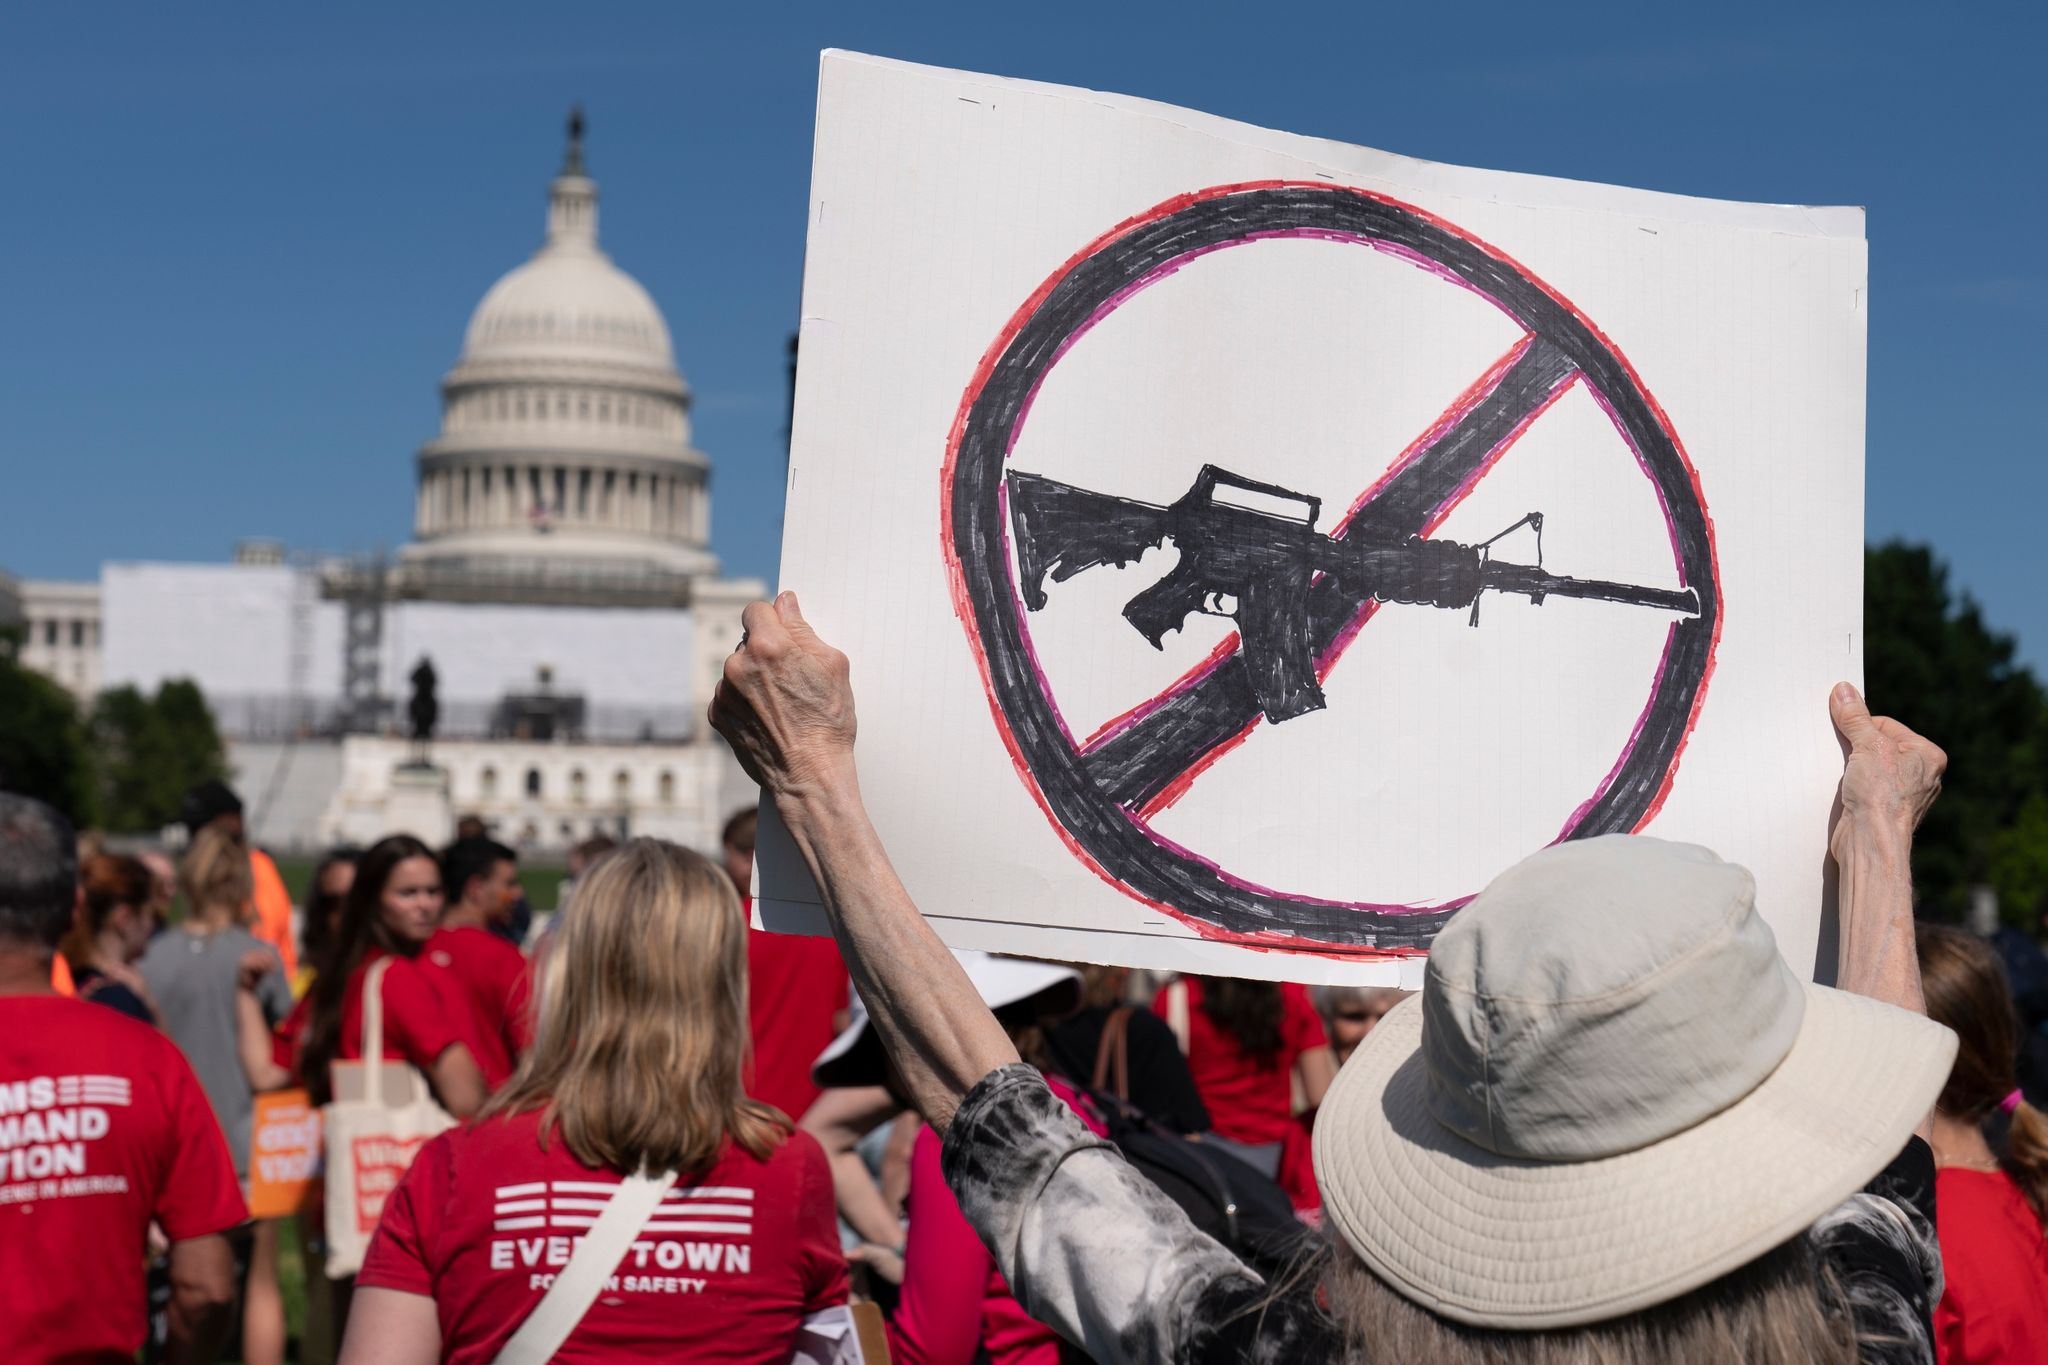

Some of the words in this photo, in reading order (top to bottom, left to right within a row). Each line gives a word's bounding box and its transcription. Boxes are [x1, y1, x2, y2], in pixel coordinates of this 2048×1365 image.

[60, 1174, 129, 1197] AMERICA
[490, 1236, 751, 1273] EVETOWN
[529, 1273, 557, 1290] FO
[623, 1275, 707, 1293] SAFETY
